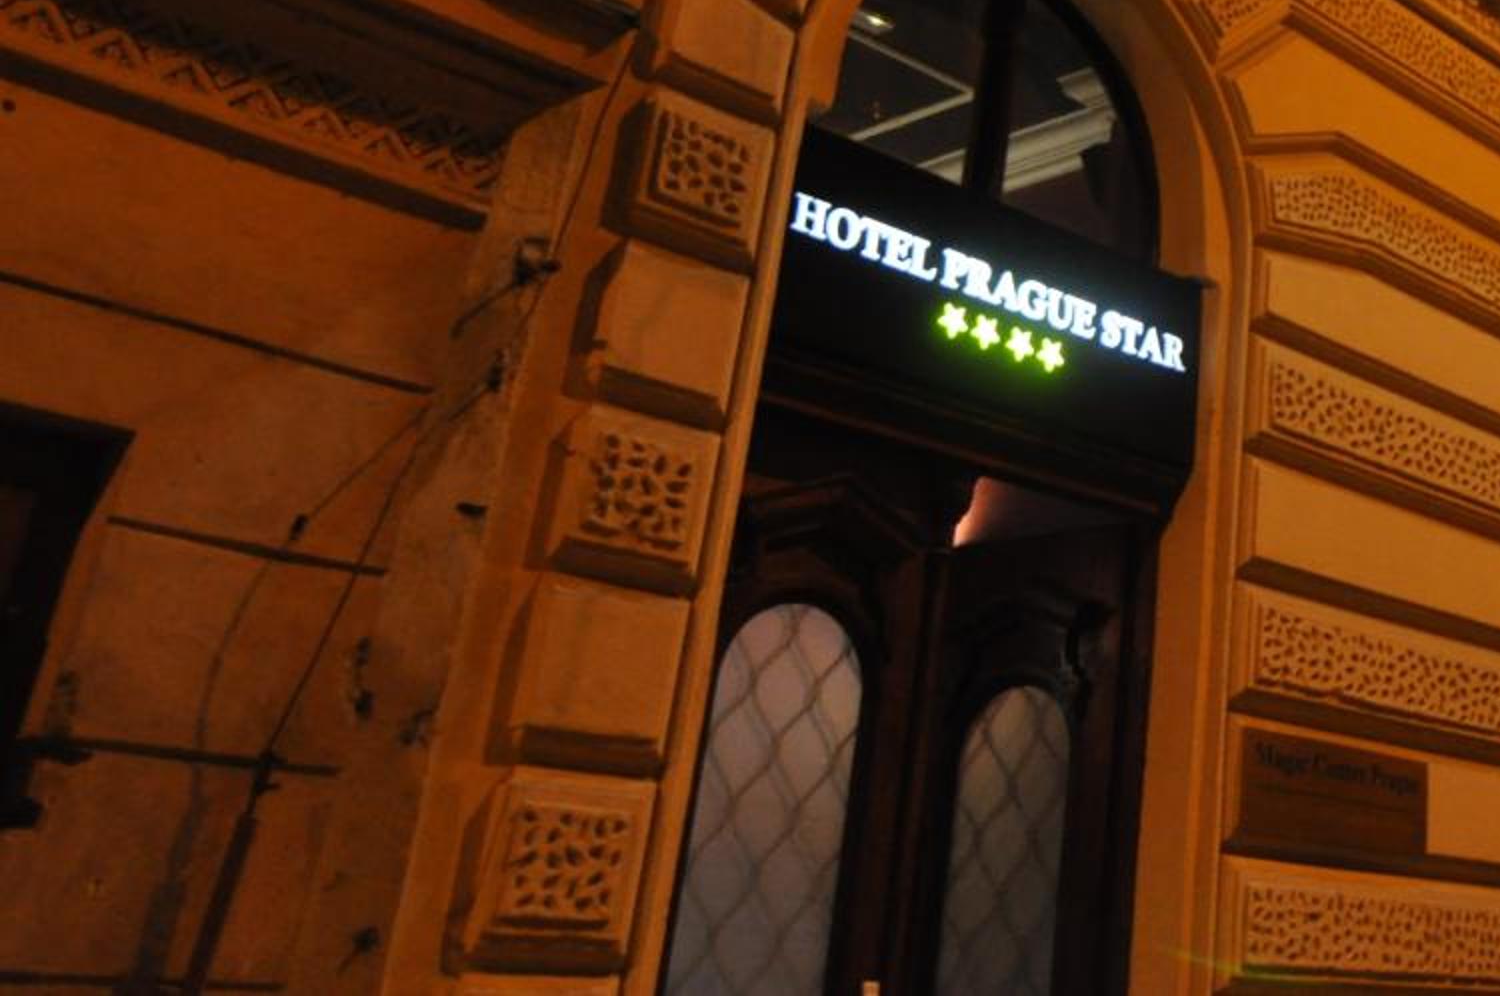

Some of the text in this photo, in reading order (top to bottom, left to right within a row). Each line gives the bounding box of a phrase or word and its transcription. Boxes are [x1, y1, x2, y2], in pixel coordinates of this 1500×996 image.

[790, 192, 1186, 373] HOTEL PRAGUE STAR
